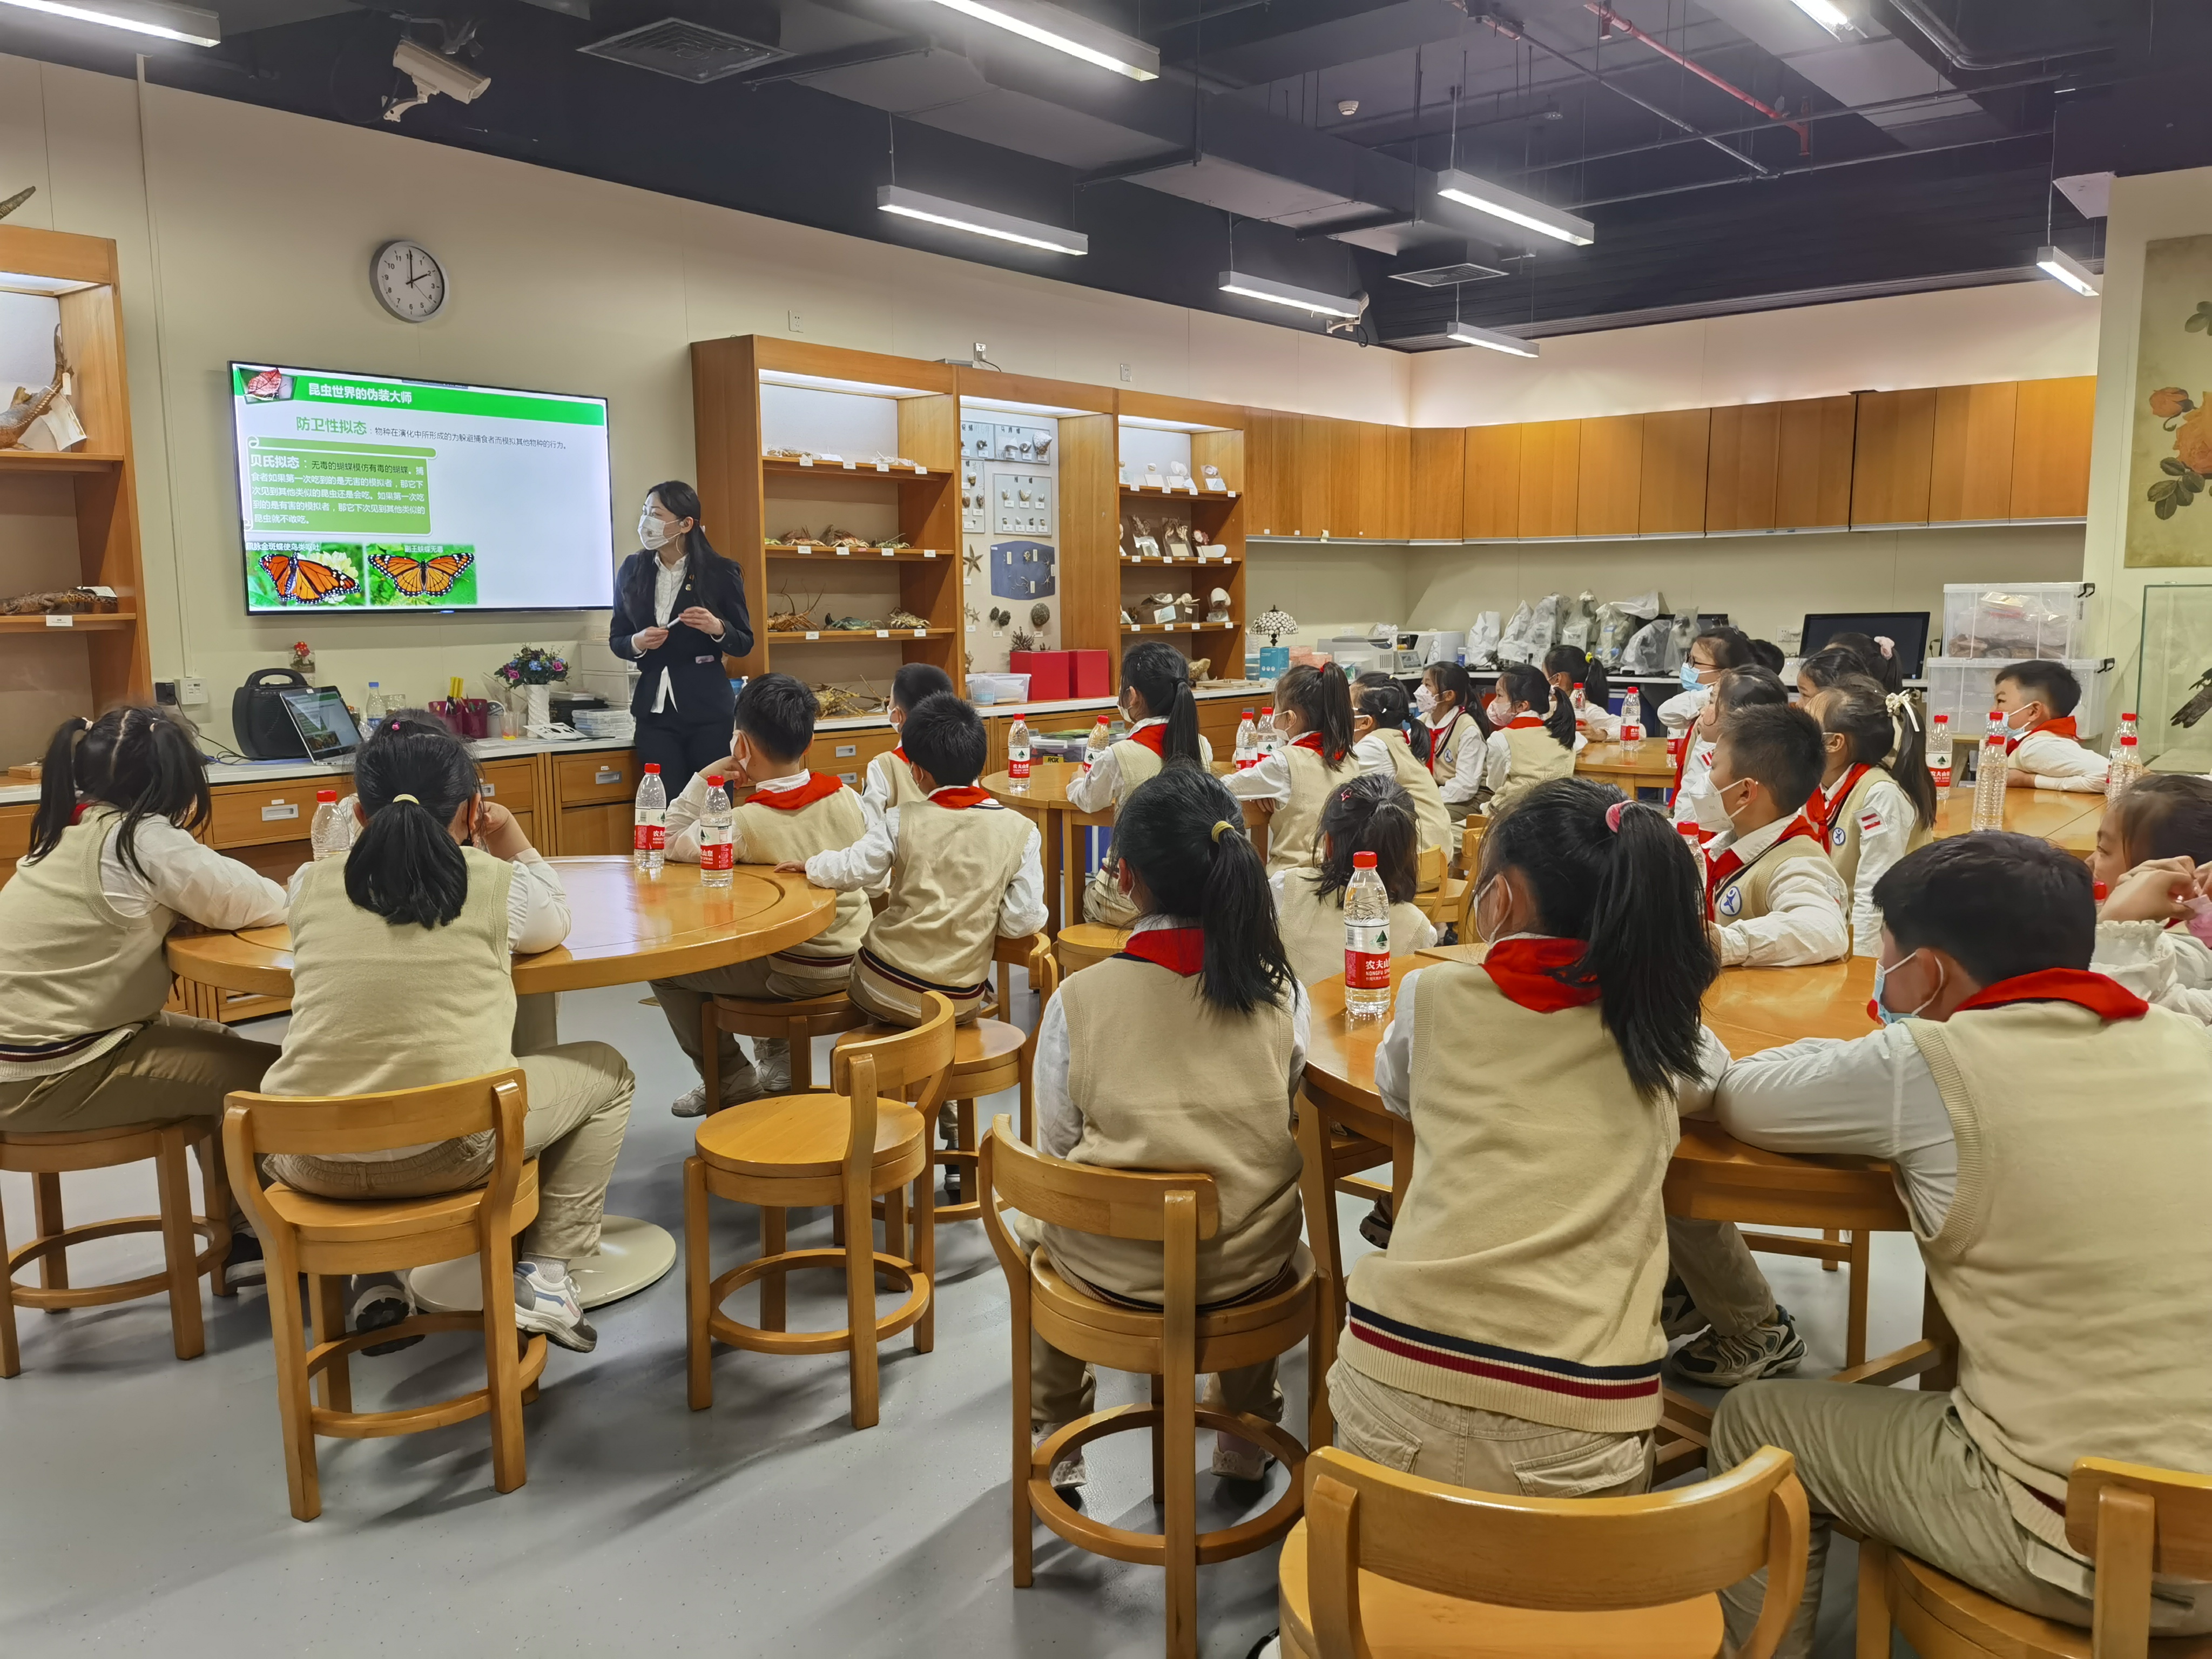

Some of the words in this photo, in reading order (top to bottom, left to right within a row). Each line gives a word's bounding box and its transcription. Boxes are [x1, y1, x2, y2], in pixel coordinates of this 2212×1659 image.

[308, 382, 412, 404] 昆虫世界的伪装大师
[254, 514, 309, 524] 昆虫就不敢吃。
[1365, 958, 1390, 970] 农夫山
